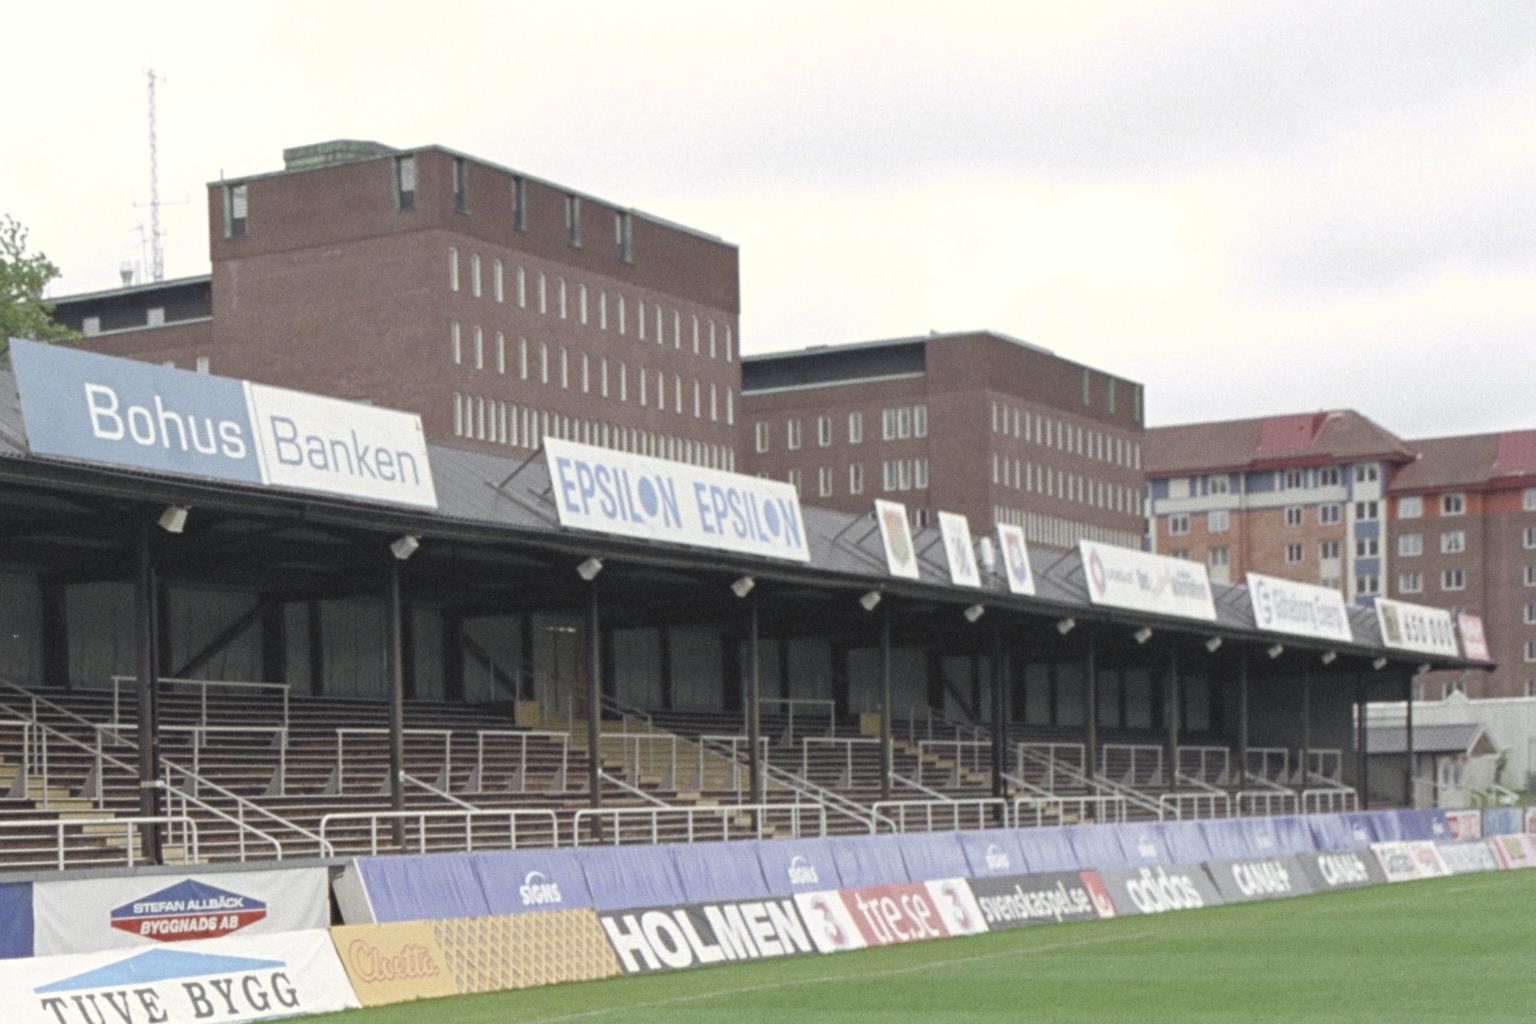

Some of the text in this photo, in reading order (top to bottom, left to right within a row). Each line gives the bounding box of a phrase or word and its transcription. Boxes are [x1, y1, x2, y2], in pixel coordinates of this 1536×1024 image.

[84, 383, 420, 486] Bohus Banken
[555, 456, 802, 548] EPSILON EPSILON
[133, 896, 245, 914] STEFAN ALLBÄCK
[519, 883, 562, 906] SIGNS
[978, 880, 1093, 922] svenskaspel.se
[1125, 866, 1204, 914] adidas
[140, 915, 239, 935] BYGGNADS AB
[601, 900, 813, 972] HOLMEN
[856, 892, 940, 944] tre.se
[182, 971, 301, 1019] BYGG
